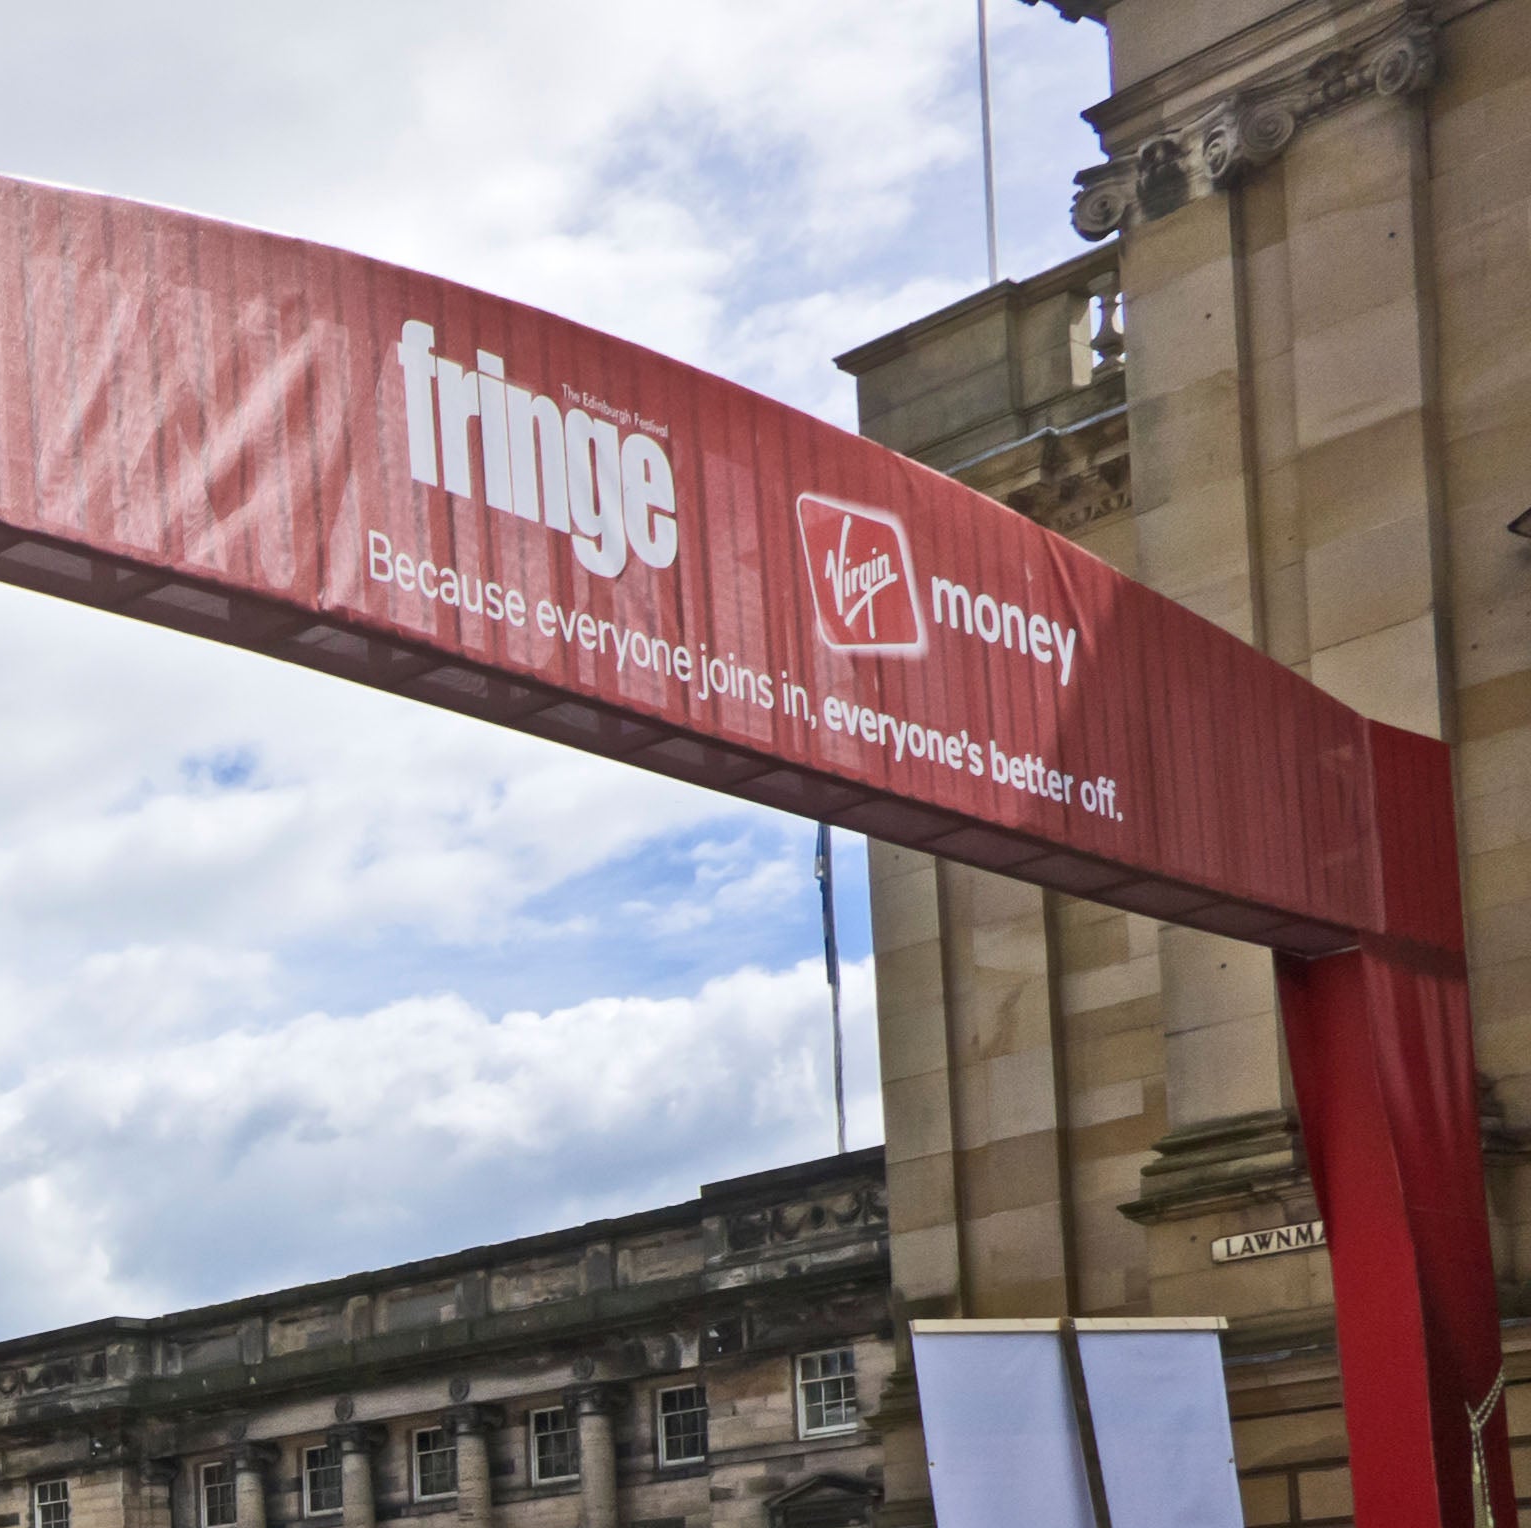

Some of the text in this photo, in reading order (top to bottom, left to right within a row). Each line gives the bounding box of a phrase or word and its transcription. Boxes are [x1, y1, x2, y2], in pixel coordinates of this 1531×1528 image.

[397, 319, 678, 579] fringe
[562, 383, 669, 438] The Edinburgh Festival
[824, 514, 898, 639] Virgin
[931, 575, 1077, 686] money
[368, 529, 1124, 822] Because everyone joins in, everyone's better off.
